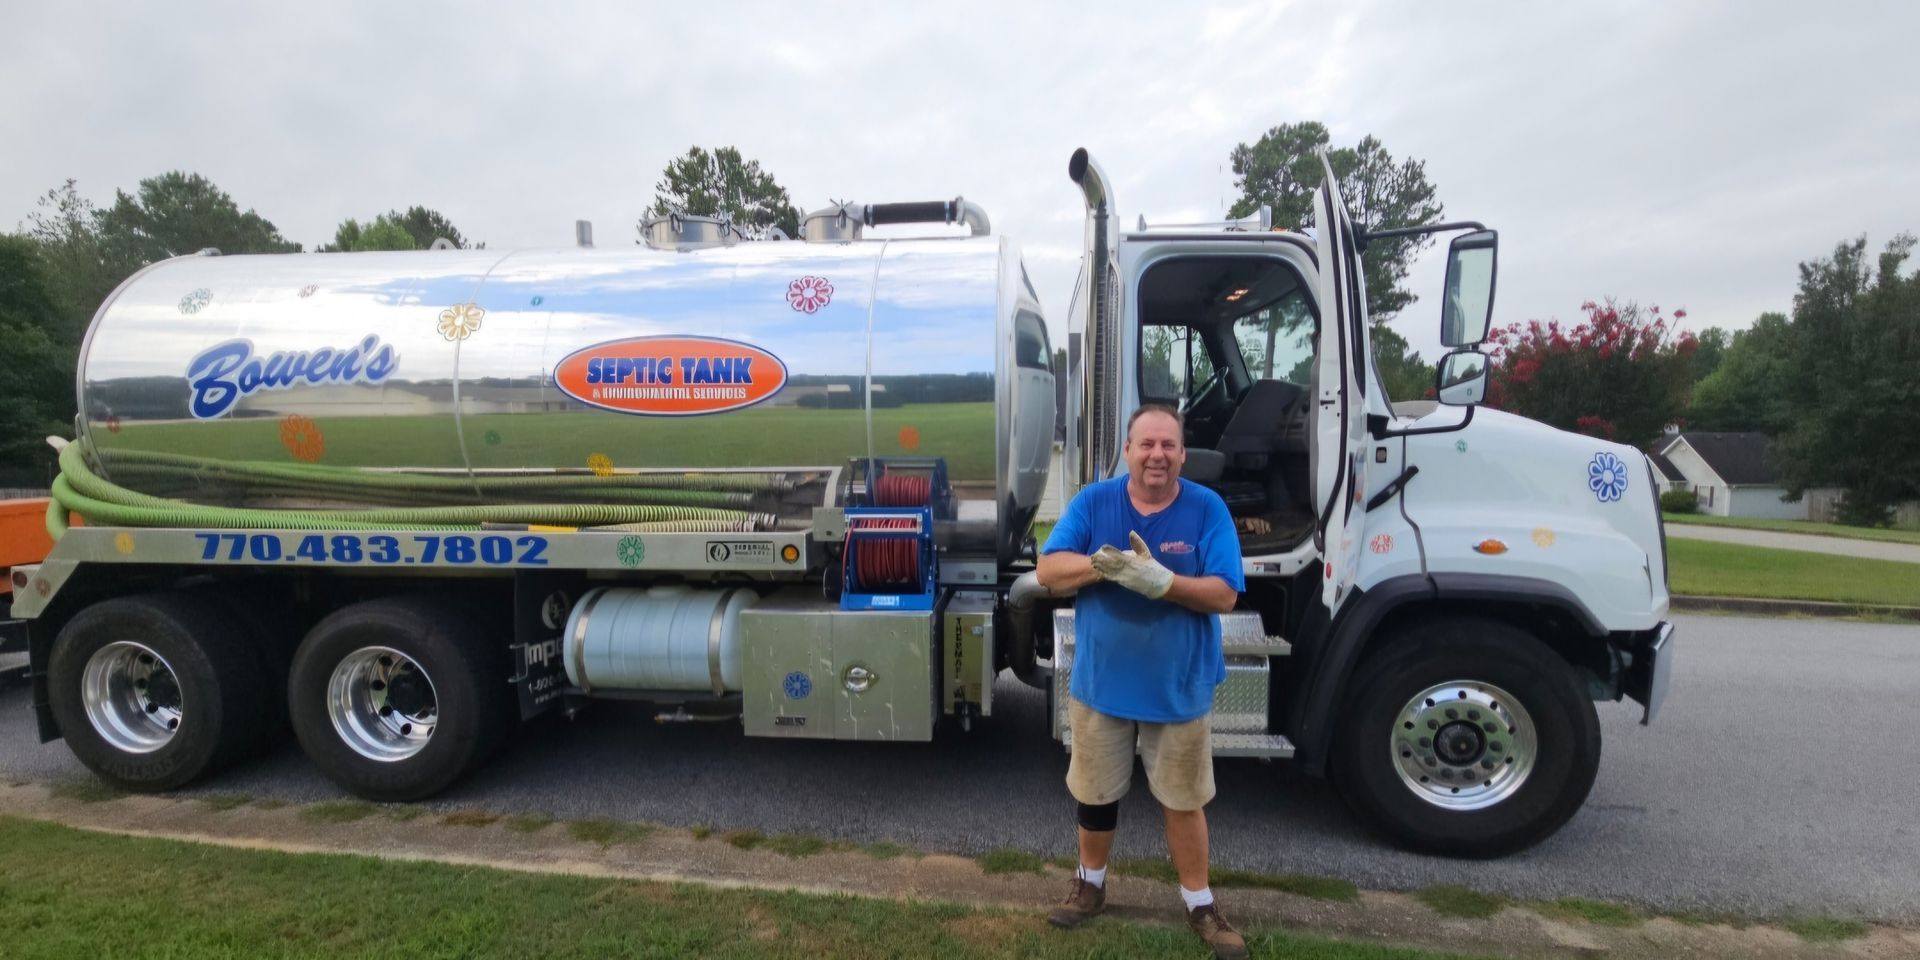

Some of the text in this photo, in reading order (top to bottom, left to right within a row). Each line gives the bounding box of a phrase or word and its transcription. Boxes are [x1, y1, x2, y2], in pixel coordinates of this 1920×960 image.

[186, 334, 397, 420] Bowen's
[586, 357, 753, 384] SEPTIC TANK
[693, 387, 747, 399] SERVICES
[195, 533, 549, 565] 770.483.7802
